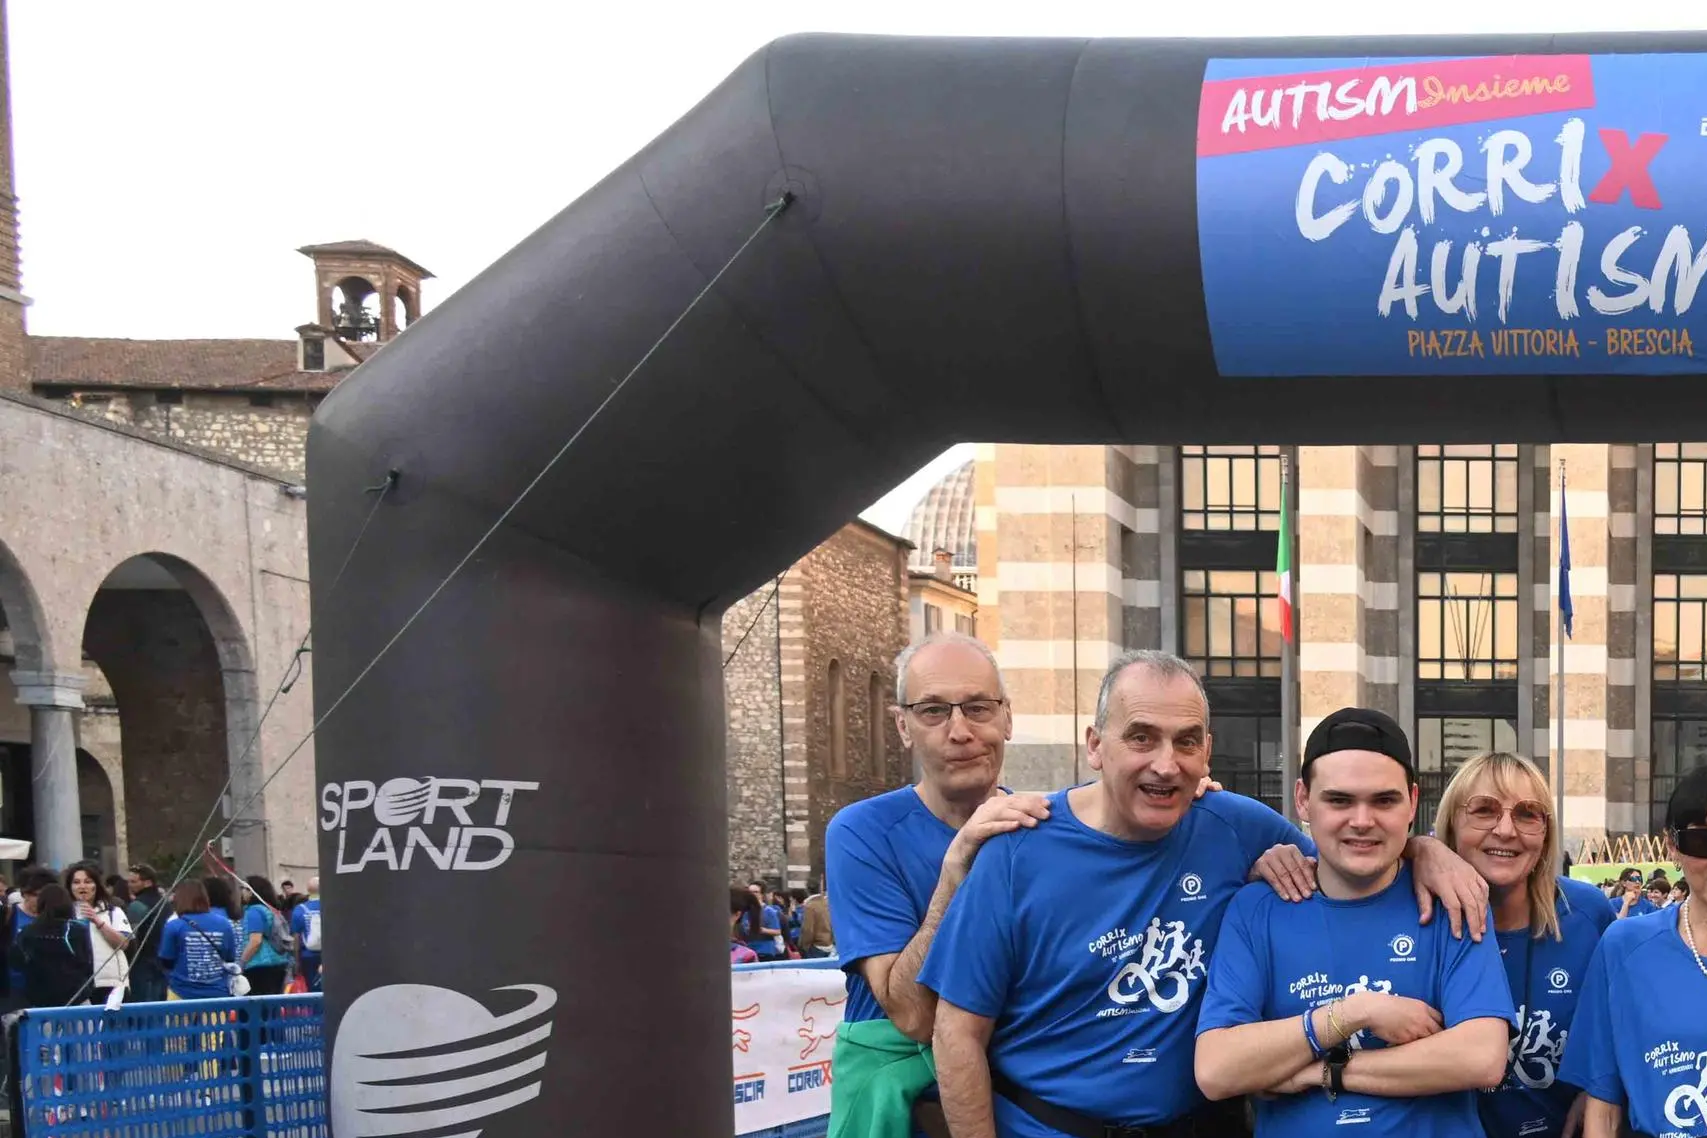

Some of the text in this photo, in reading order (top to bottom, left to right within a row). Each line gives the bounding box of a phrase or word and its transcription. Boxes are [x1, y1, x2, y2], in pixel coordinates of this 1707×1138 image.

[1407, 329, 1485, 359] PIAZZA
[1490, 328, 1581, 358] VITTORIA
[1606, 328, 1694, 357] BRESCIA
[320, 776, 540, 831] SPORT
[336, 826, 516, 874] LAND
[1102, 933, 1144, 957] AUTISMO
[1300, 984, 1343, 1000] AUTISMO
[1653, 1051, 1696, 1069] AUTISMO
[787, 1060, 833, 1094] CORRIX
[734, 1079, 765, 1104] SCIA
